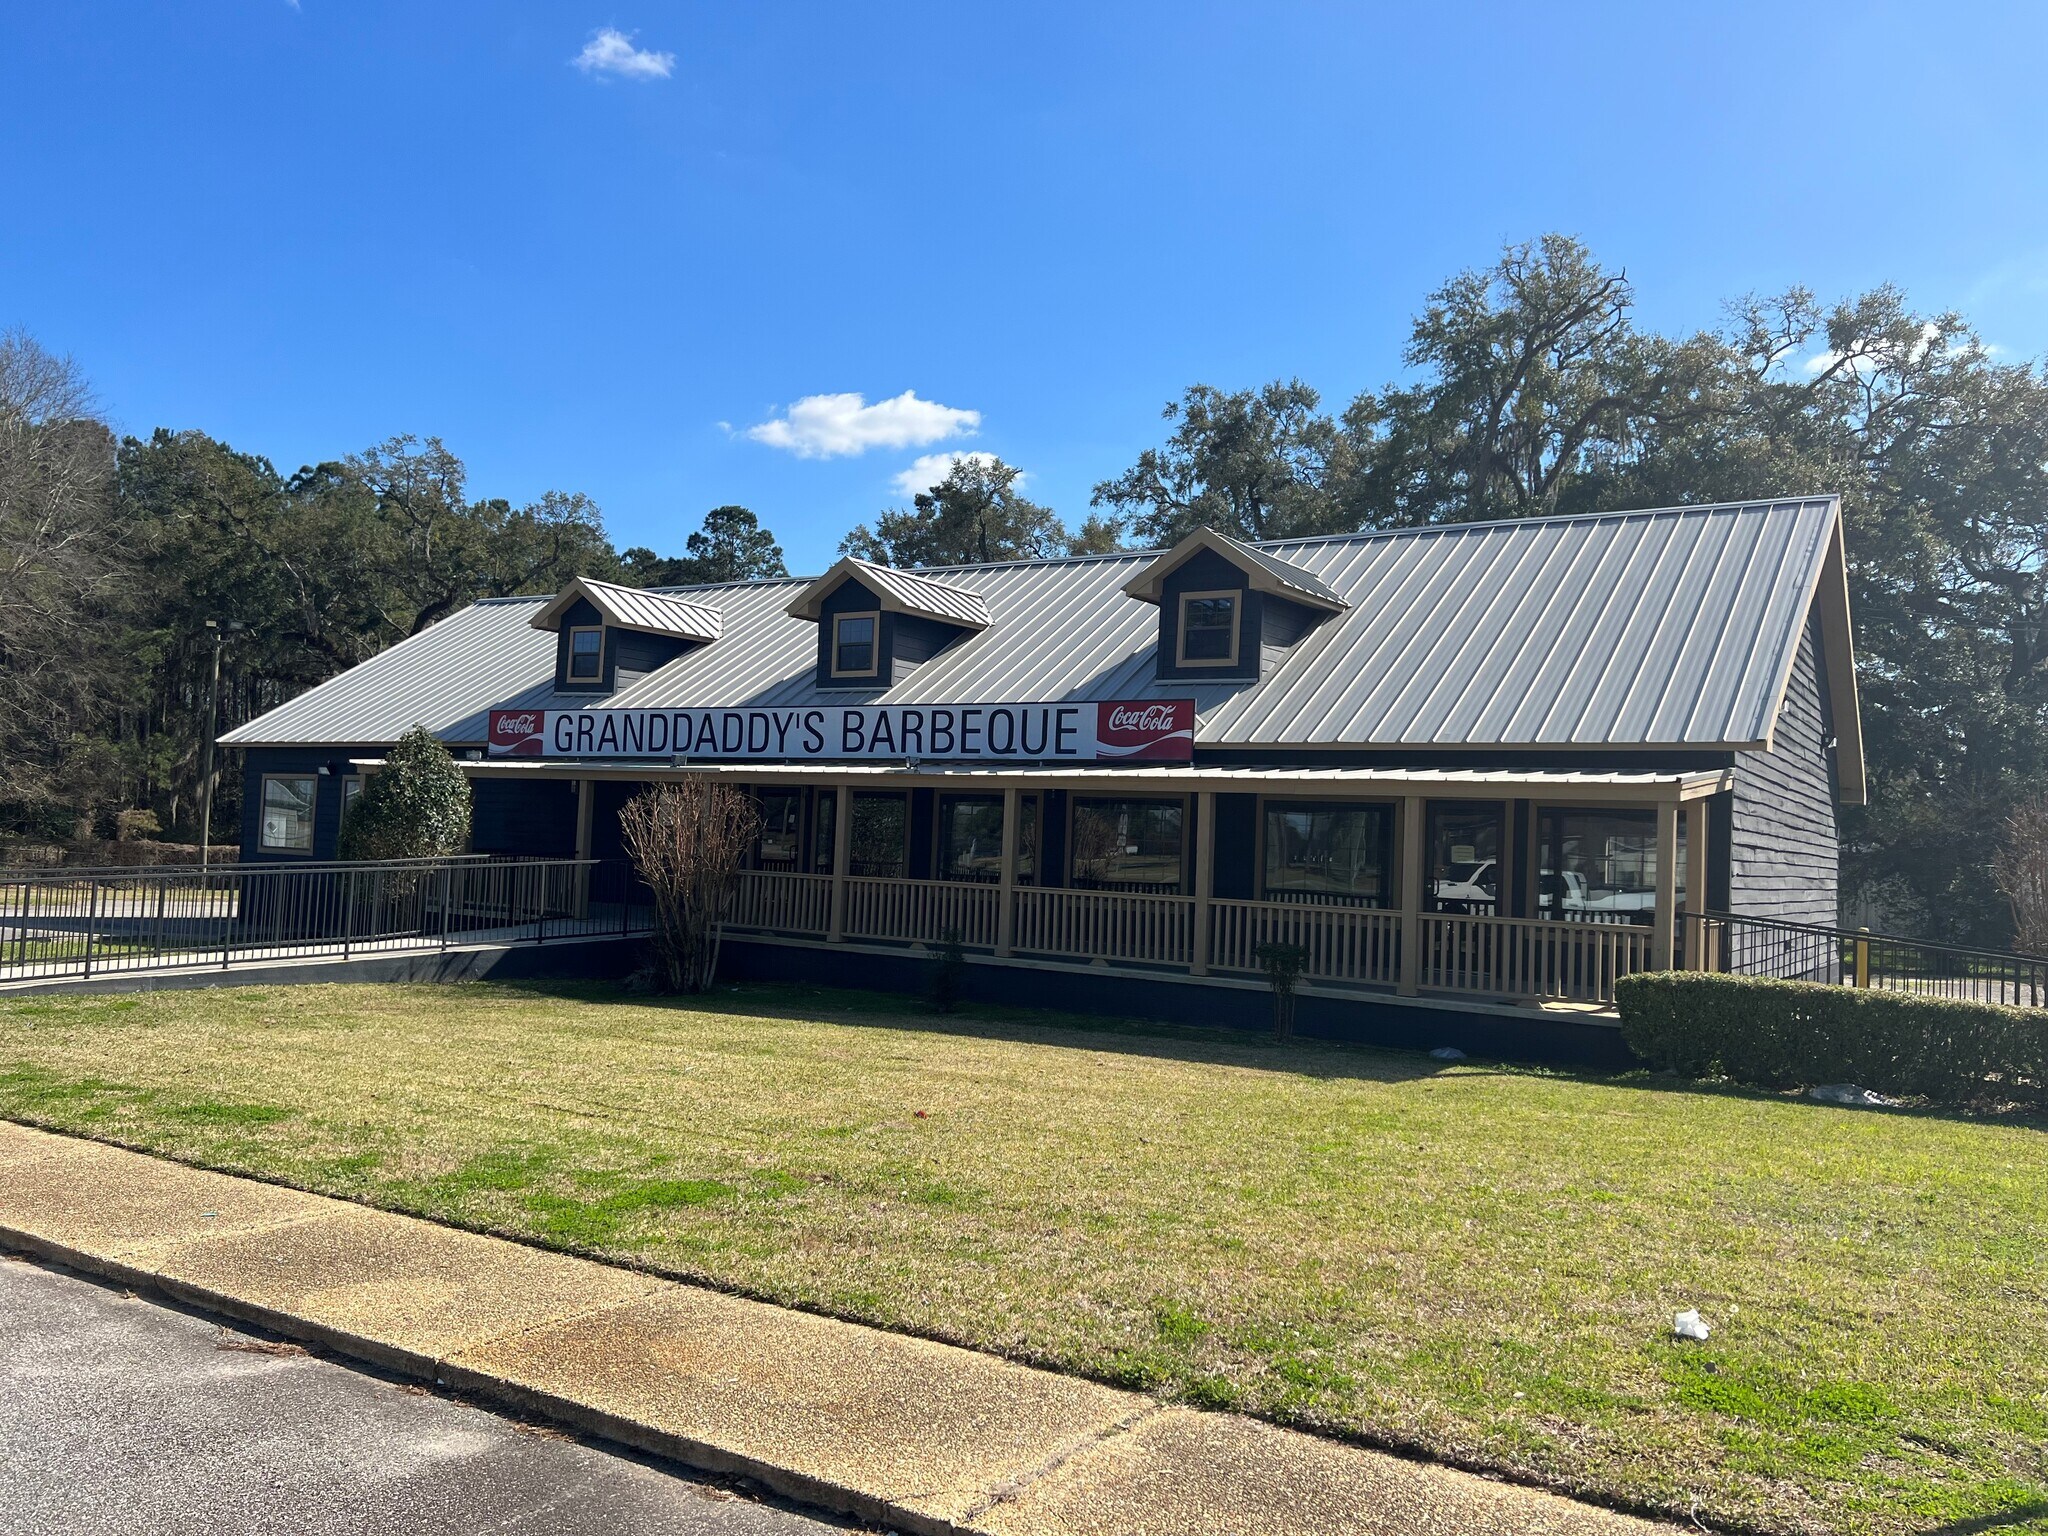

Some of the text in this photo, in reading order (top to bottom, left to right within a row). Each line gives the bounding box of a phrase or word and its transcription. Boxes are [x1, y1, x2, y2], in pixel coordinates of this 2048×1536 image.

[554, 708, 1079, 754] GRANDDADDY'S BARBEQUE
[1108, 705, 1176, 731] Coca-Cola
